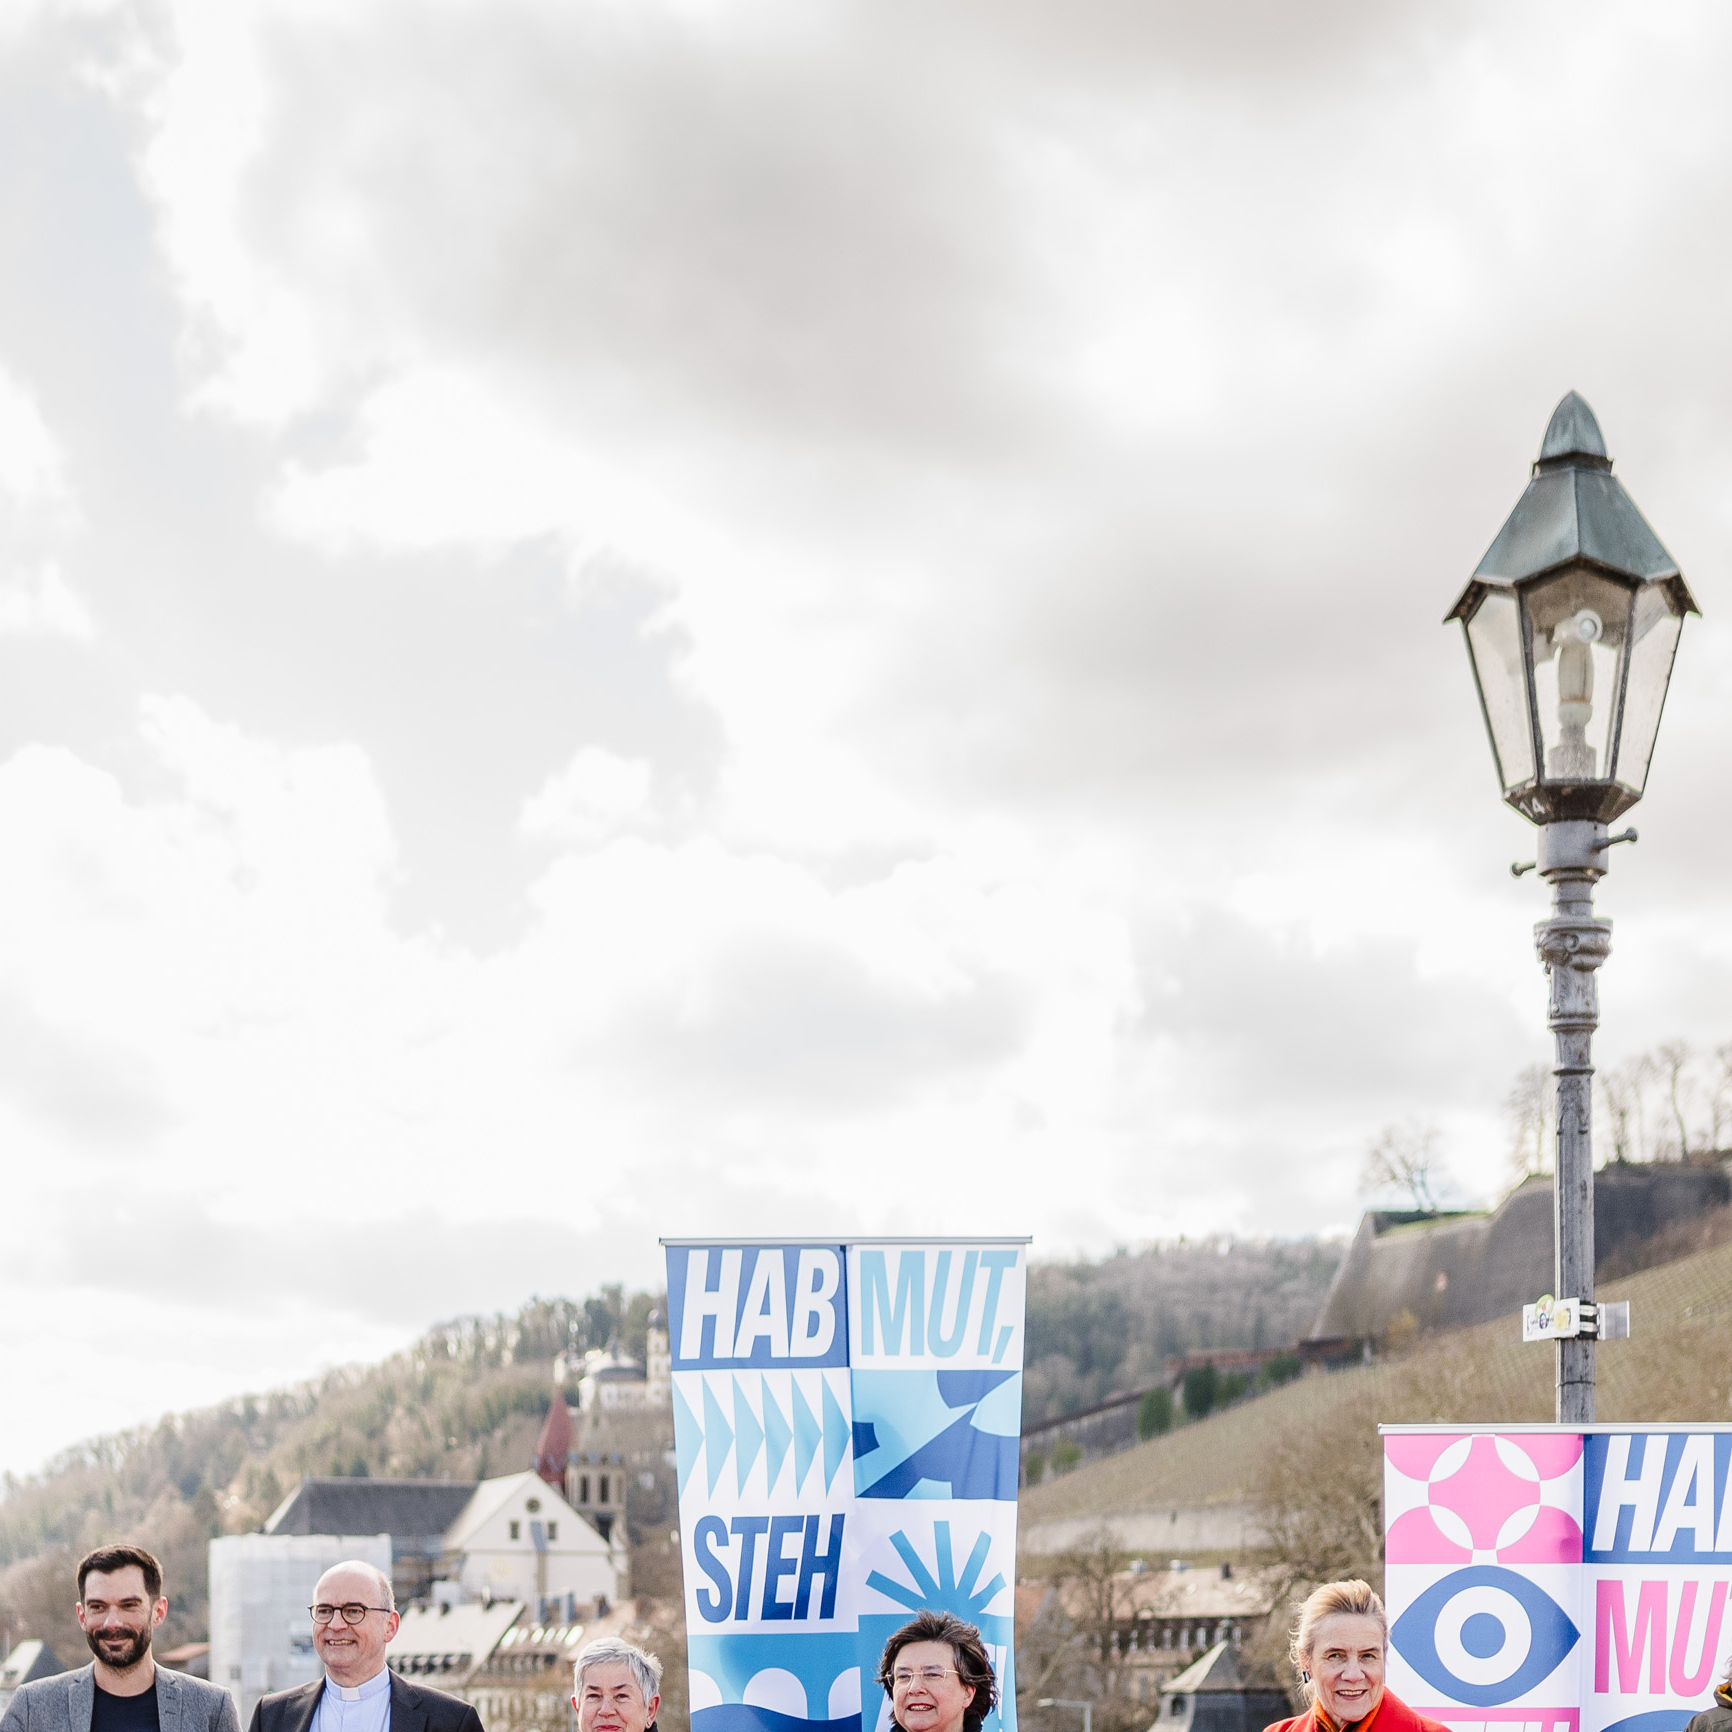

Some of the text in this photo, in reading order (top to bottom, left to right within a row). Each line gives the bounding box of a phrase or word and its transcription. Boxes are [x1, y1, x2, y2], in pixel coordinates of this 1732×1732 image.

[679, 1249, 1018, 1364] HAB MUT,
[693, 1513, 845, 1623] STEH
